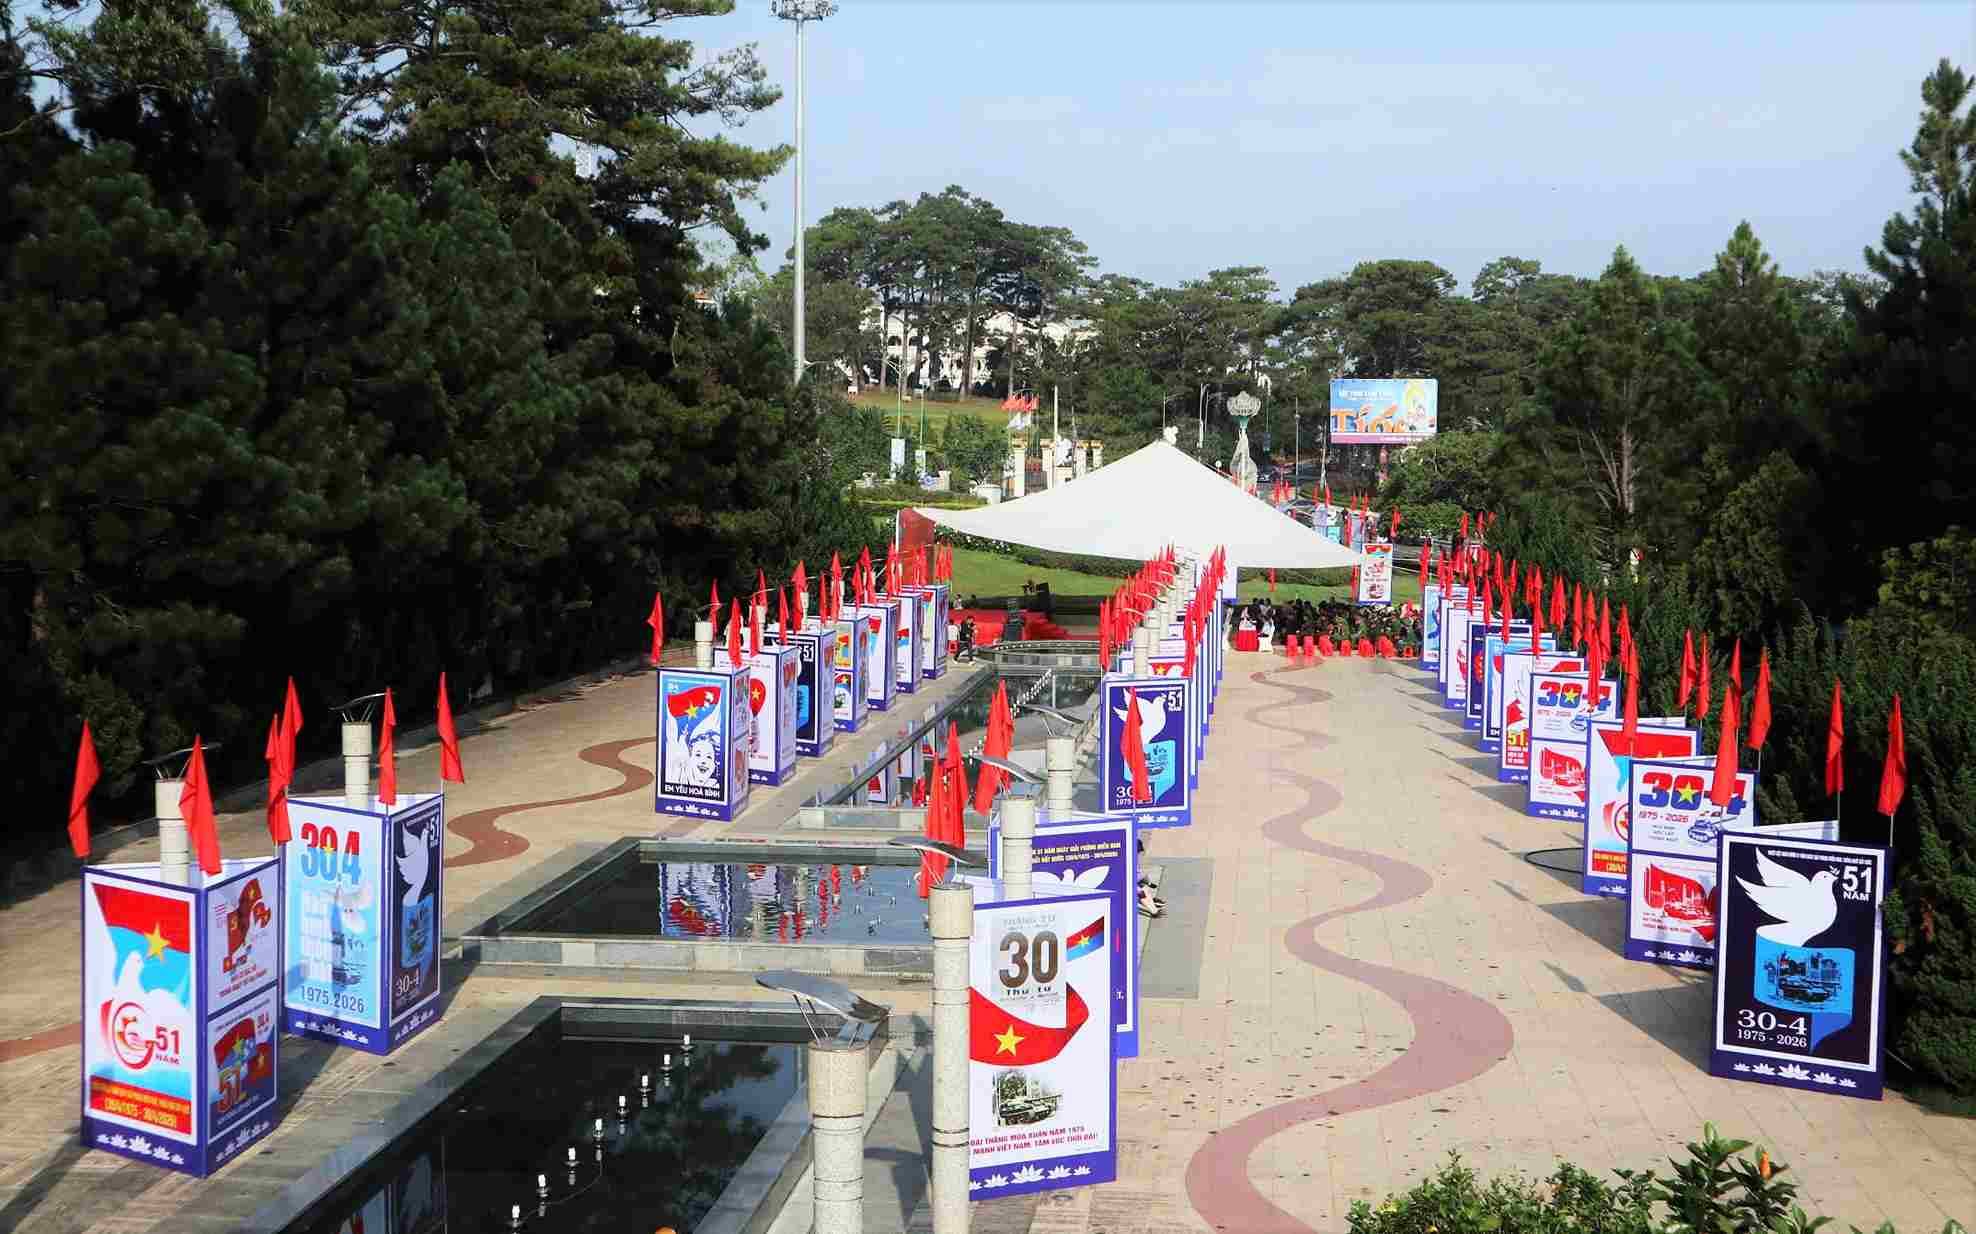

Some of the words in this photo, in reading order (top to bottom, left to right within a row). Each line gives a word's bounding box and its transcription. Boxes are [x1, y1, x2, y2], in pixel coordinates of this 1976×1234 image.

[1167, 691, 1183, 706] 51
[300, 822, 362, 886] 30.4
[1842, 865, 1872, 893] 51
[1843, 890, 1870, 902] NĂM
[998, 930, 1059, 989] 30
[1737, 1009, 1808, 1036] 30-4
[155, 1025, 180, 1055] 51
[1737, 1028, 1766, 1042] 1975
[1776, 1033, 1808, 1048] 2026
